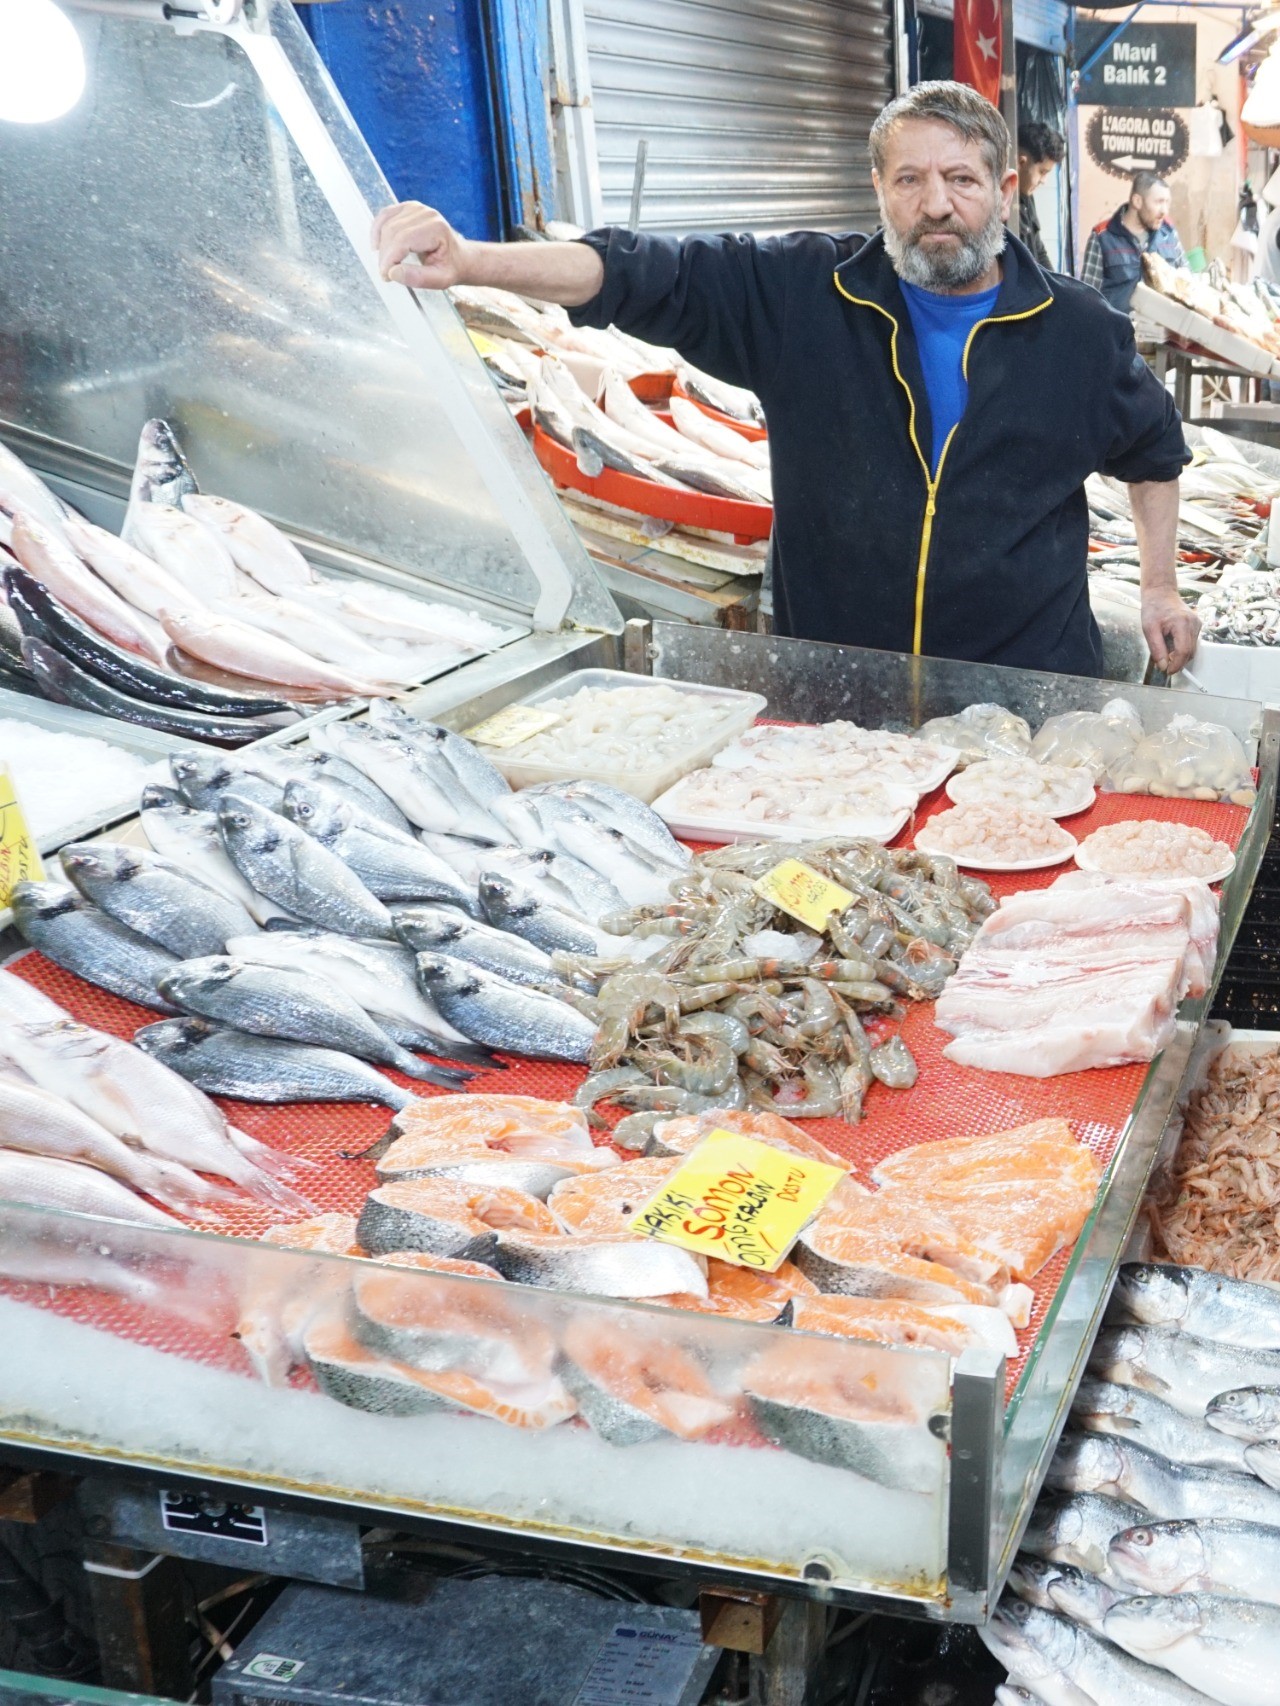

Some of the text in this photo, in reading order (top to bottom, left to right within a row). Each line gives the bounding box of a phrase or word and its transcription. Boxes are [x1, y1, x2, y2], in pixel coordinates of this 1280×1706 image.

[1113, 42, 1157, 61] Mavi
[1103, 65, 1167, 85] Balık 2
[1102, 115, 1176, 137] L'AGORA OLD
[1102, 135, 1174, 156] TOWN HOTEL
[776, 1167, 807, 1202] DOSTU
[683, 1163, 755, 1240] SOMON
